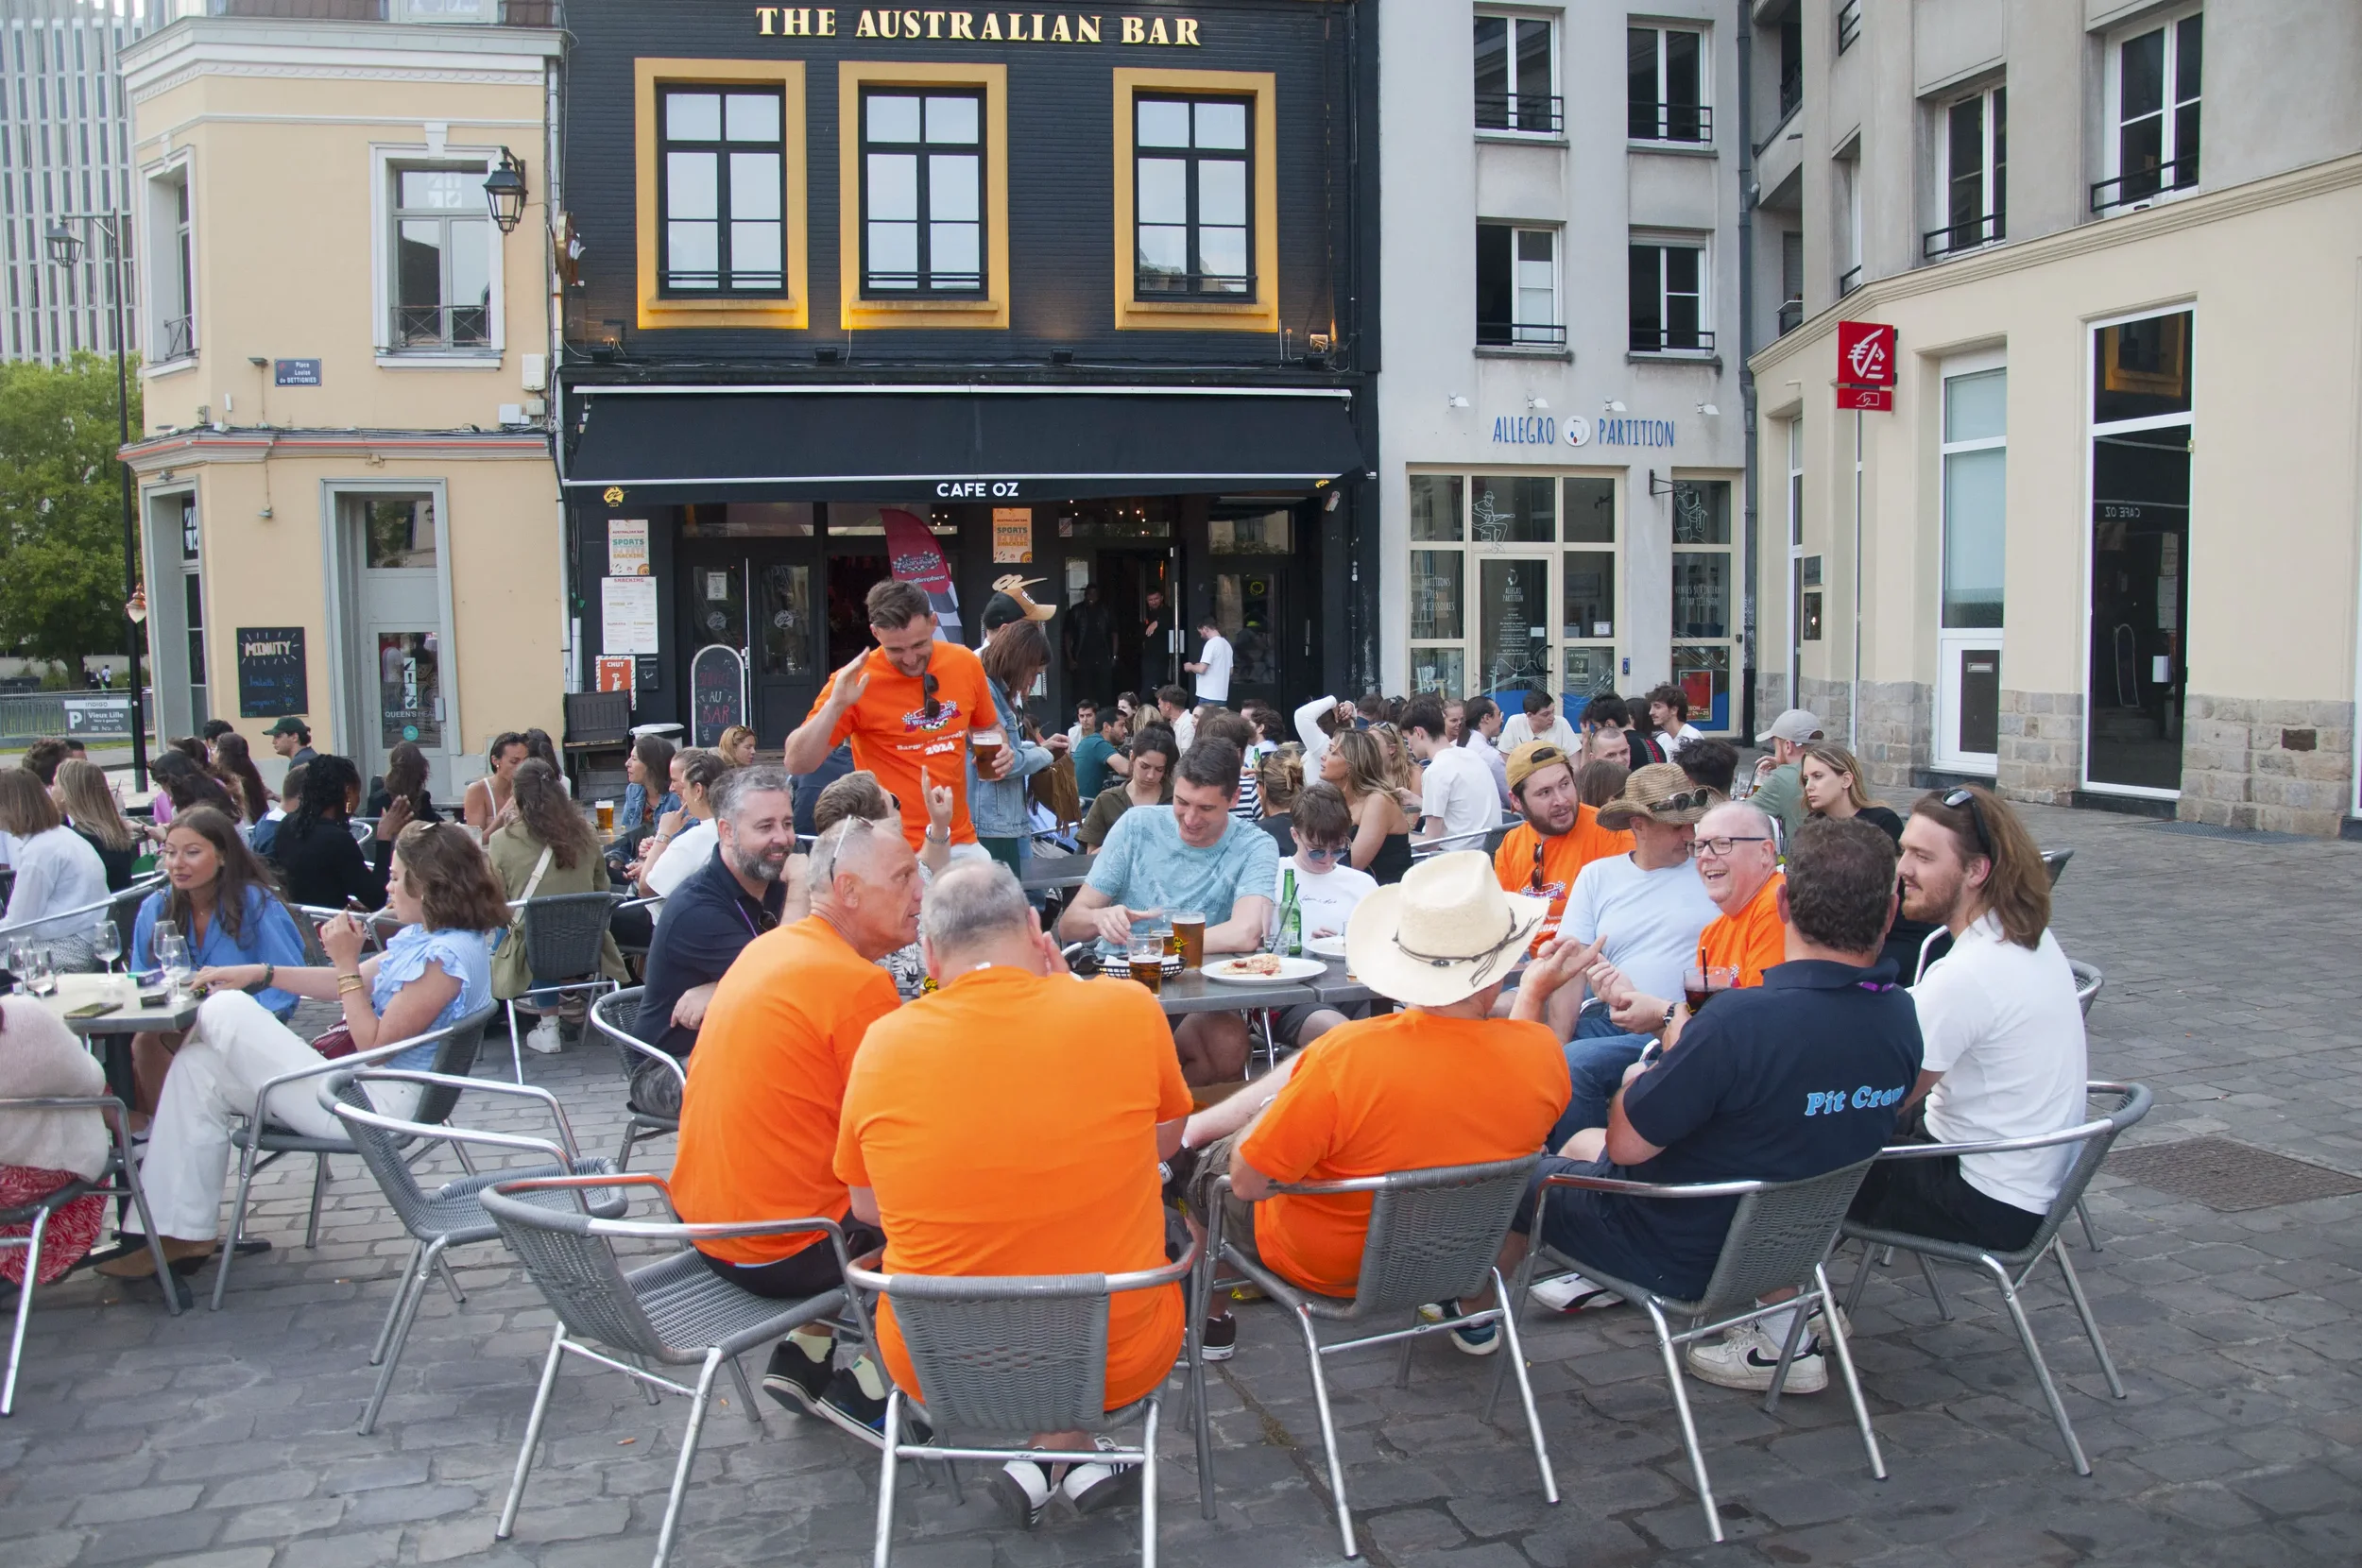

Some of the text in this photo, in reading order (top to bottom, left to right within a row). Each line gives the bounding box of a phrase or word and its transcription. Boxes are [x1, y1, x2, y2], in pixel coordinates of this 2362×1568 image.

[756, 8, 1201, 46] THE AUSTRALIAN BAR
[1493, 416, 1675, 448] ALLEGRO PARTITION
[936, 482, 1019, 497] CAFE OZ
[245, 641, 291, 656] MINUTY
[709, 691, 722, 703] AU
[69, 711, 83, 729] P
[702, 705, 730, 724] BAR
[925, 741, 955, 756] 2024
[1804, 1088, 1847, 1116] Pit
